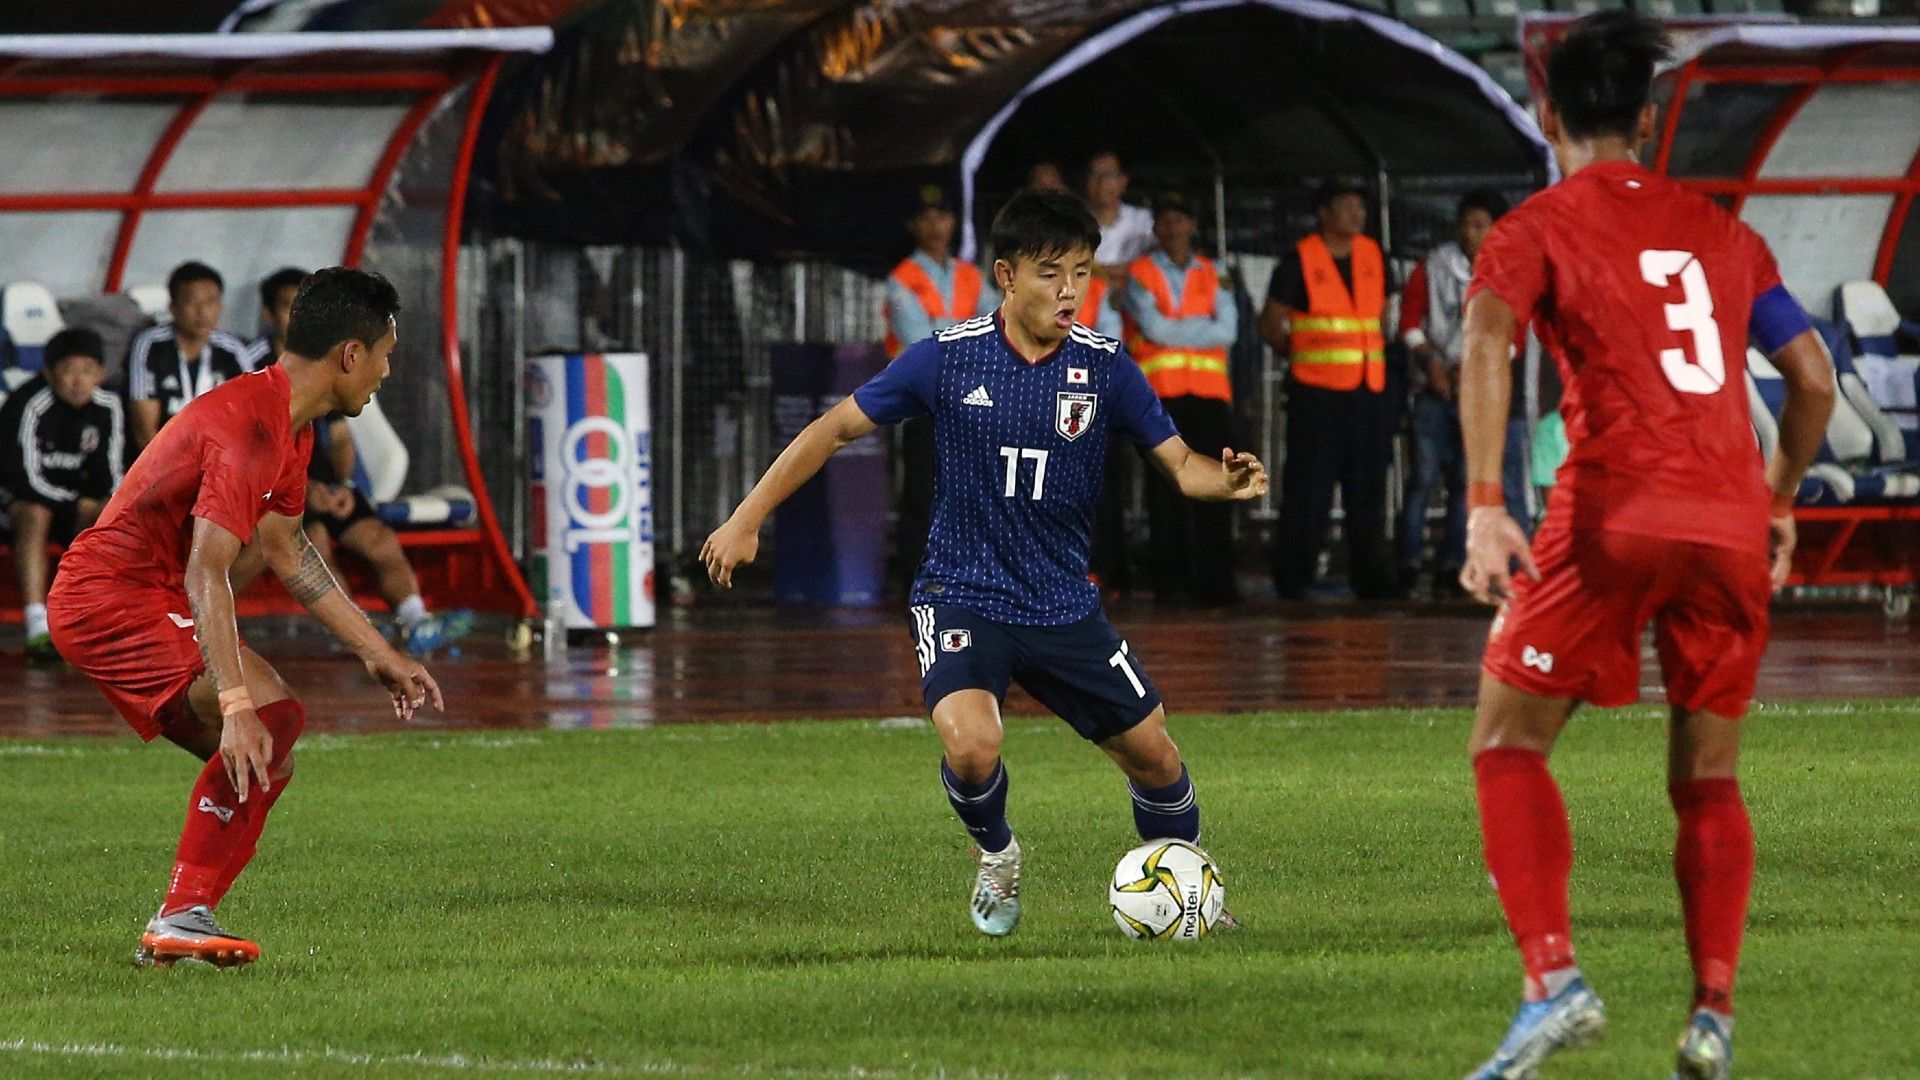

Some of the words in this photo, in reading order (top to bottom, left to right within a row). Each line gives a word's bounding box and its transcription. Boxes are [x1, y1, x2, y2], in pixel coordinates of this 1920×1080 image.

[1638, 249, 1726, 395] 3
[963, 397, 994, 408] adidas
[562, 415, 631, 553] 100
[1000, 446, 1049, 500] 17
[1183, 883, 1198, 938] molten
